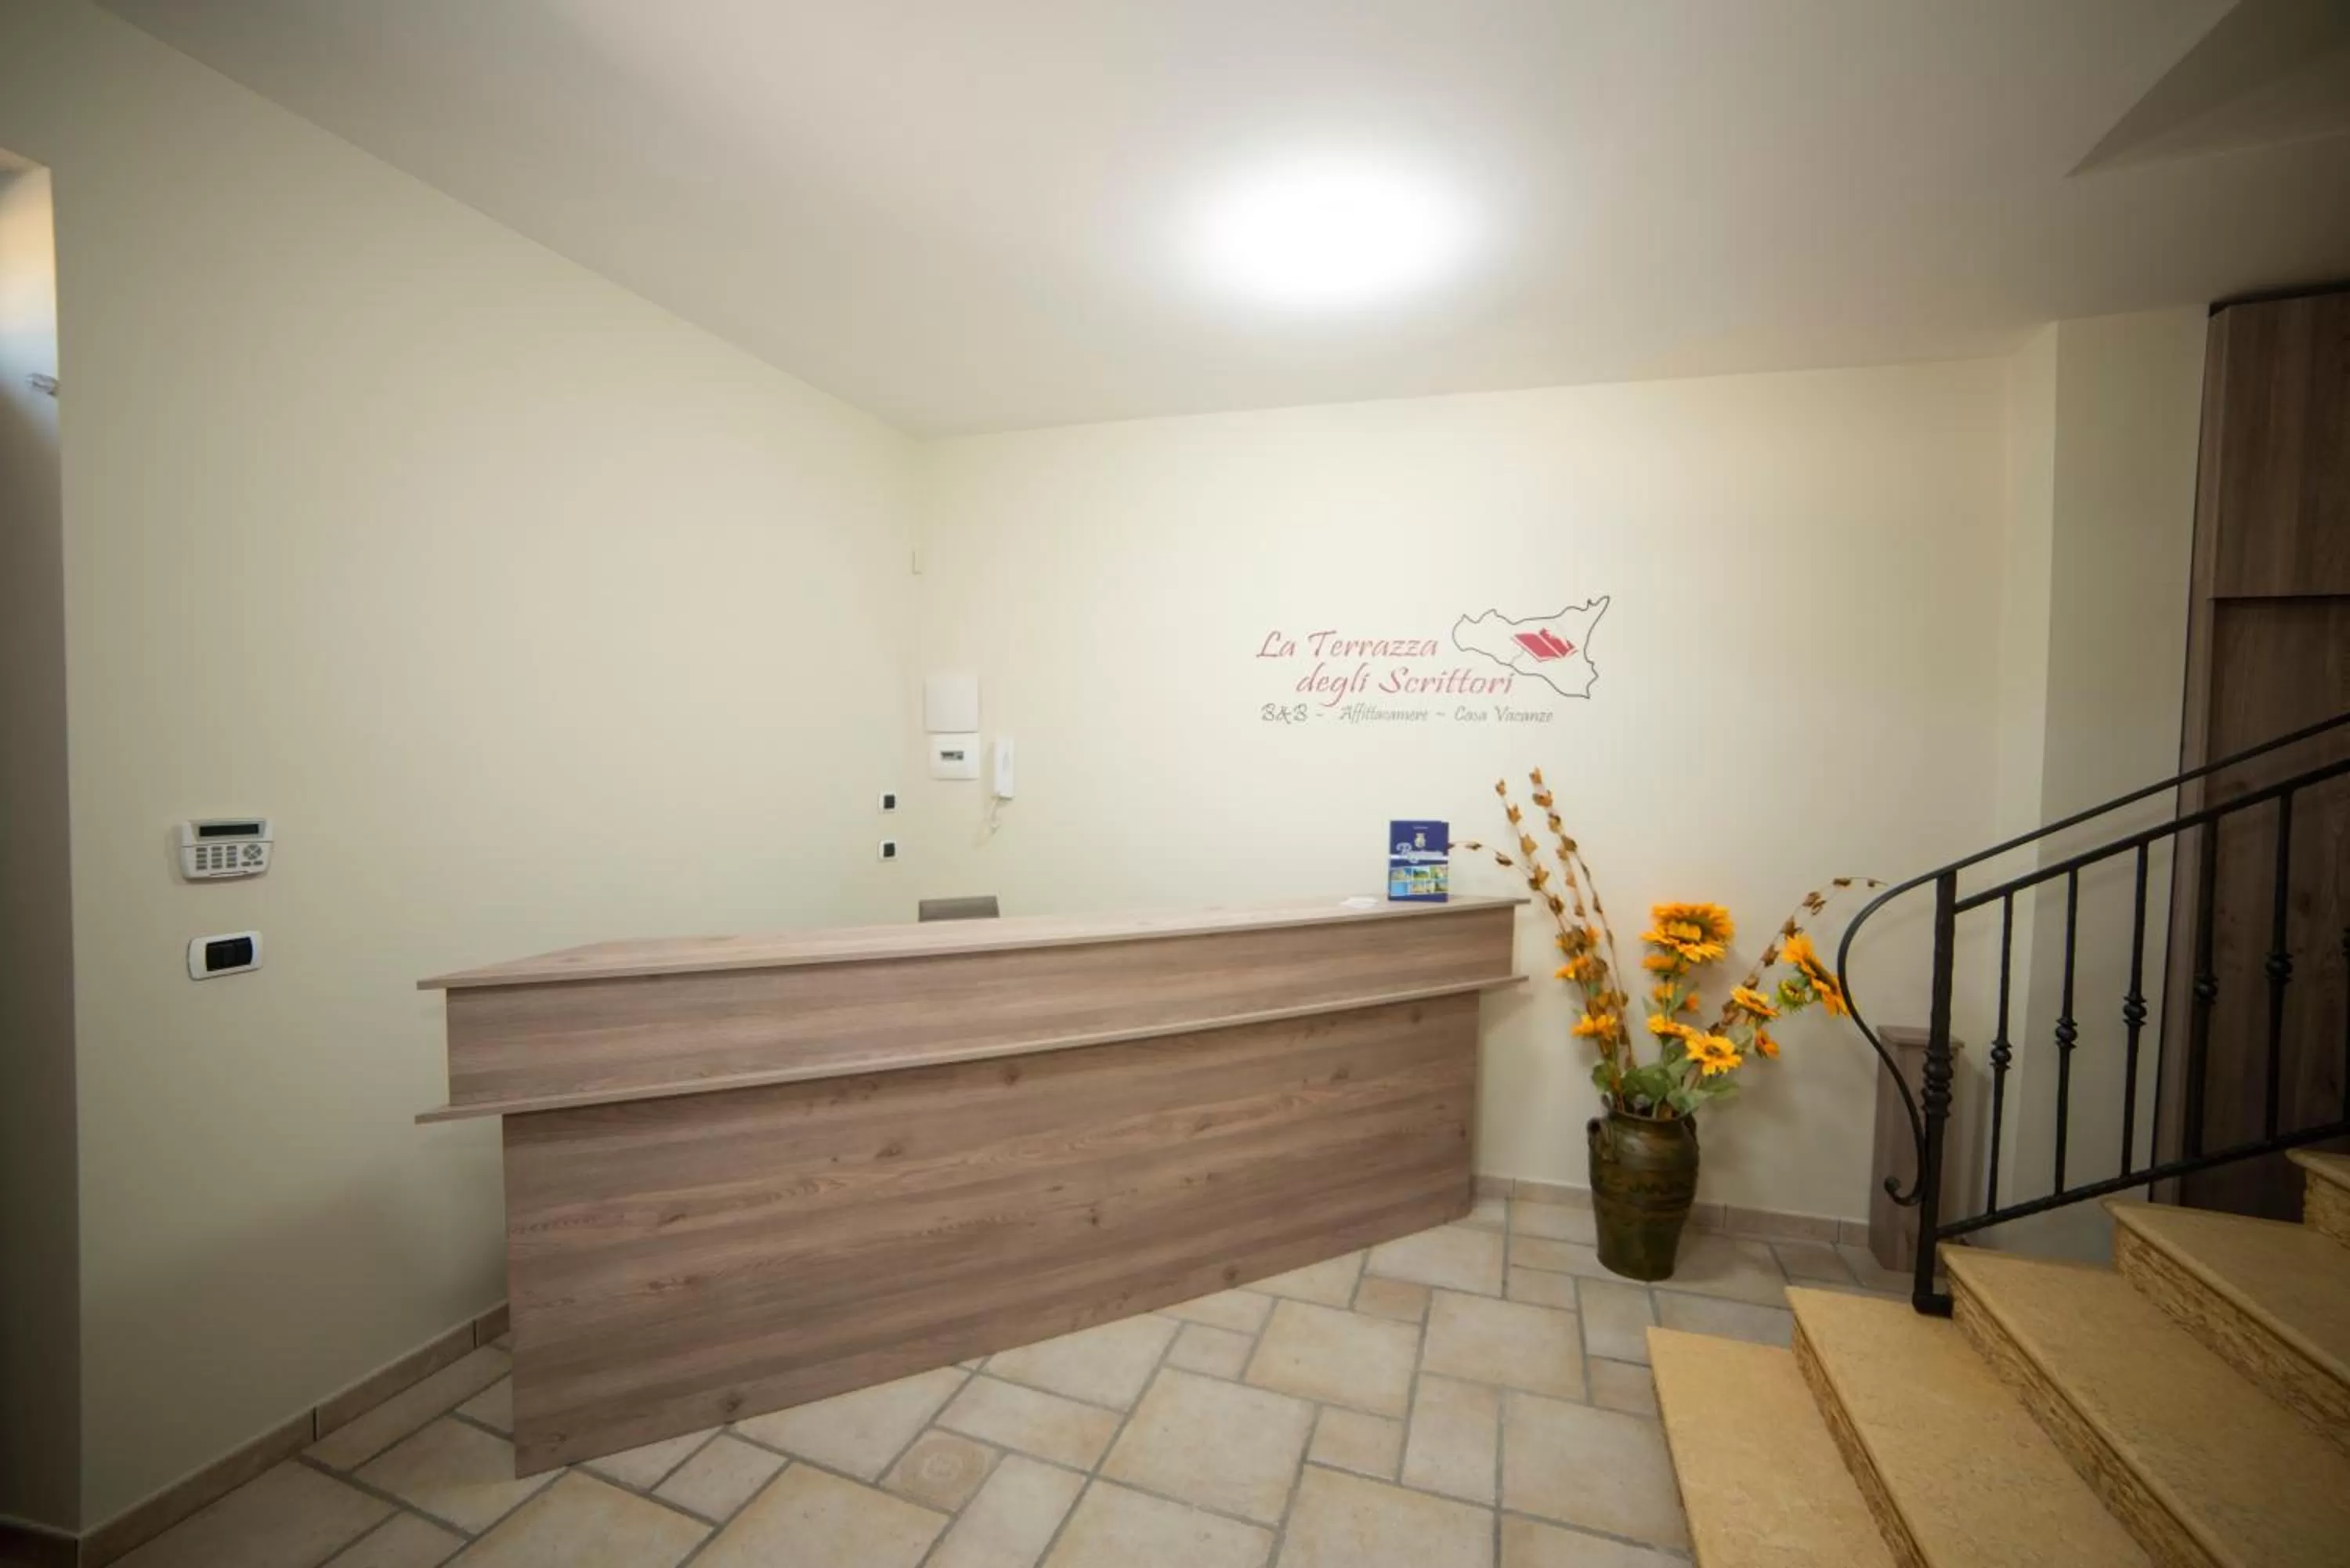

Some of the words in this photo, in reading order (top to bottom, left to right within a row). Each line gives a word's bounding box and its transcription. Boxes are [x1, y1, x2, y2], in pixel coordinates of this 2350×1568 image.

[1256, 630, 1296, 658] La
[1307, 629, 1439, 658] Terrazza
[1295, 661, 1370, 708] degli
[1378, 666, 1516, 694] Scrittori
[1261, 703, 1308, 724] B&B
[1340, 702, 1429, 723] Affittacamere
[1454, 705, 1488, 722] Casa
[1494, 705, 1553, 722] Vacanze
